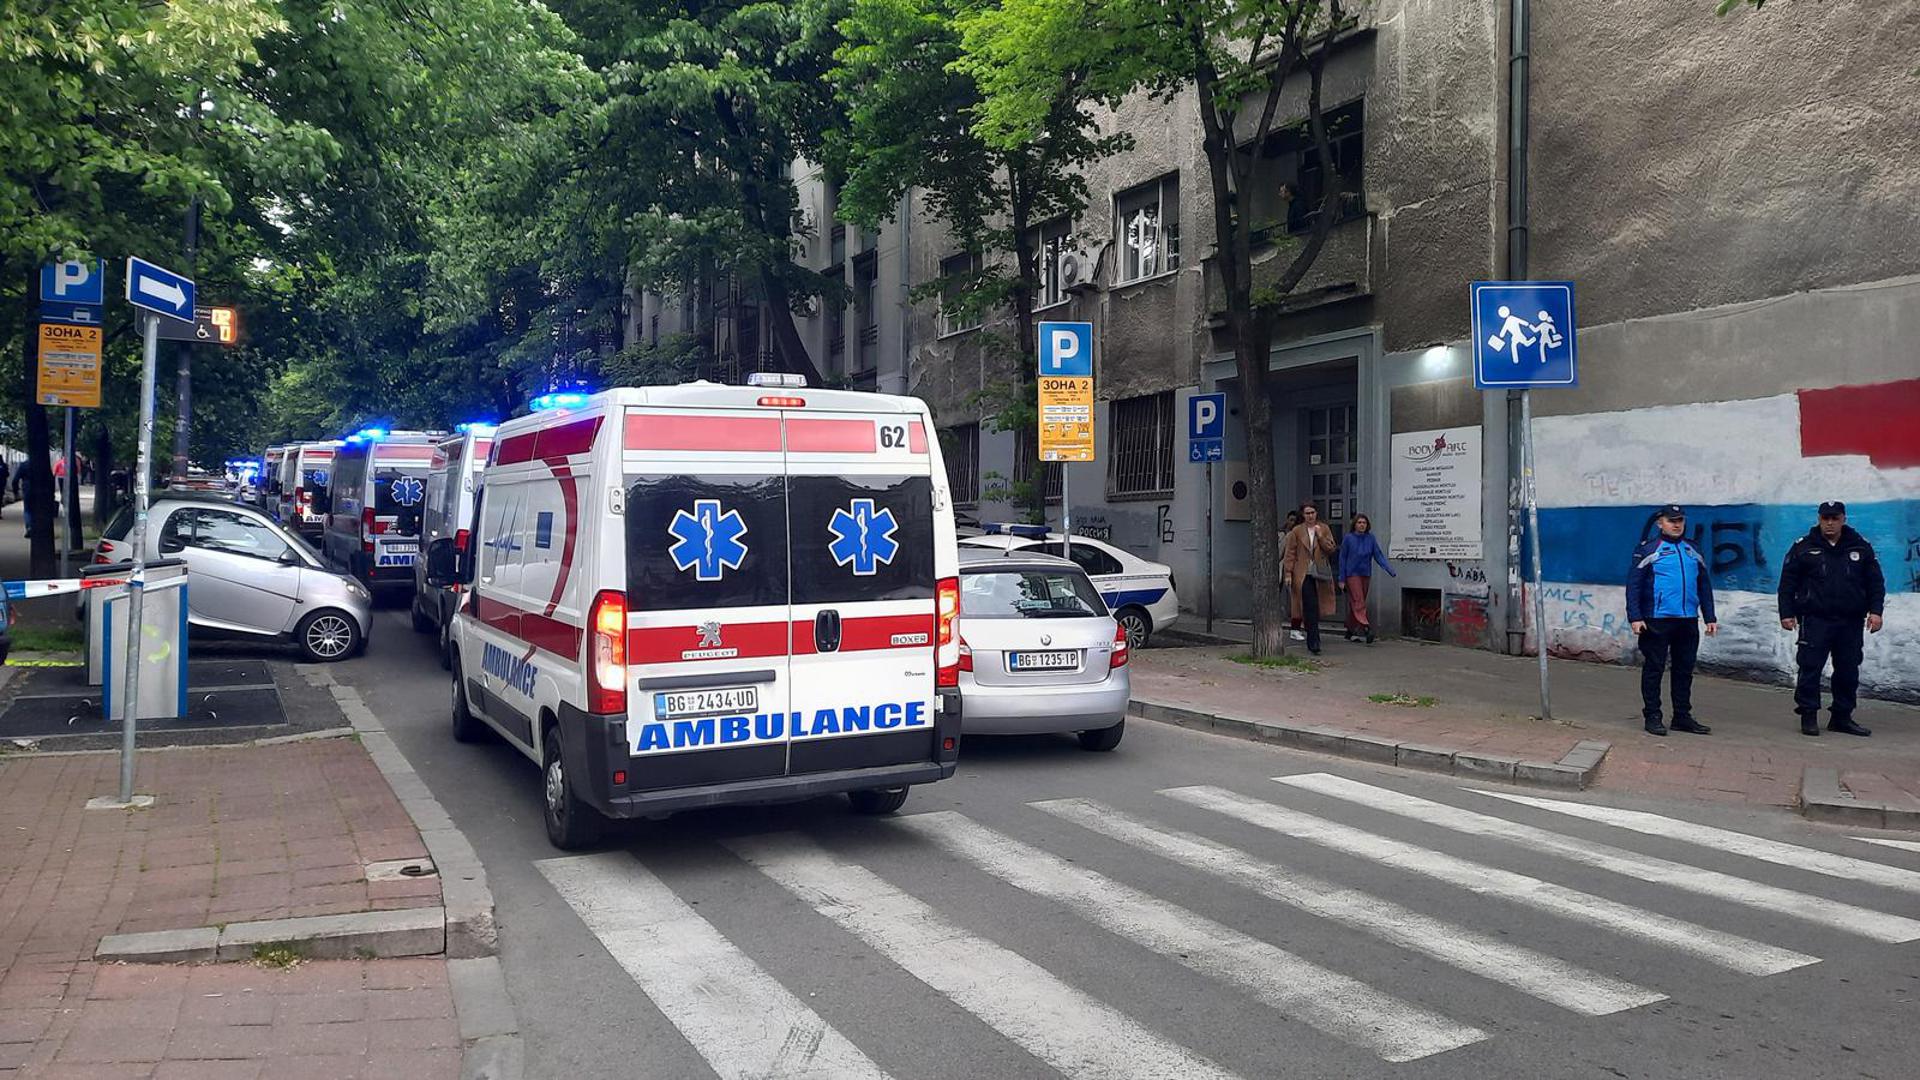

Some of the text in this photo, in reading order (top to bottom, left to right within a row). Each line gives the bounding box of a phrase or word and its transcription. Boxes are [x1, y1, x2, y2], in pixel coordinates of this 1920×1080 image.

[55, 257, 89, 296] P
[44, 327, 97, 339] ЗОНА 2
[1052, 330, 1079, 369] P
[1043, 380, 1089, 390] ЗОНА 2
[1196, 400, 1217, 434] P
[880, 426, 905, 448] 62
[893, 635, 926, 644] BOXER
[684, 650, 737, 659] PEUGEOT
[1018, 654, 1032, 667] BG
[482, 642, 538, 700] AMBULANCE
[667, 696, 686, 712] BG
[637, 701, 926, 752] AMBULANCE
